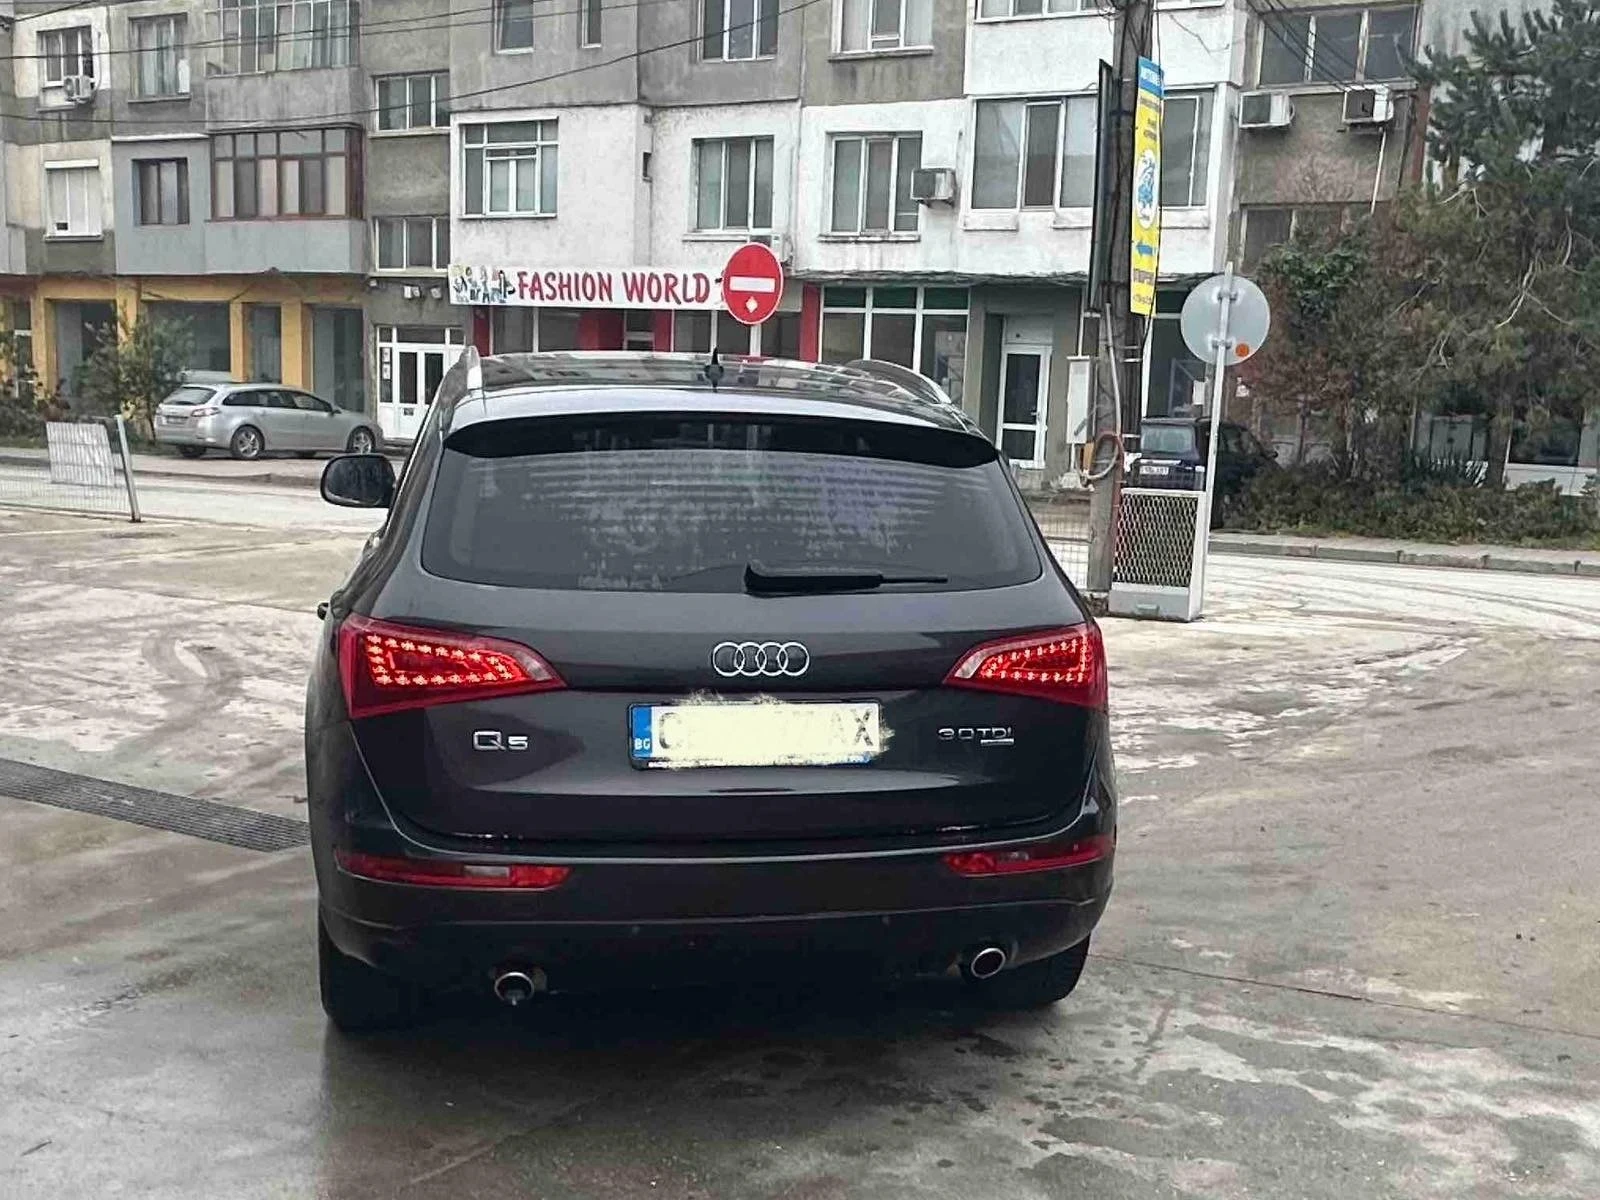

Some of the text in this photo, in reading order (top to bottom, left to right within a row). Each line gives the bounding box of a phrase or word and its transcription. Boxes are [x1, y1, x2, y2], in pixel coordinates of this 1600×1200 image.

[517, 271, 710, 305] FASHION WORLD
[473, 731, 529, 751] Q5
[634, 738, 651, 751] BG
